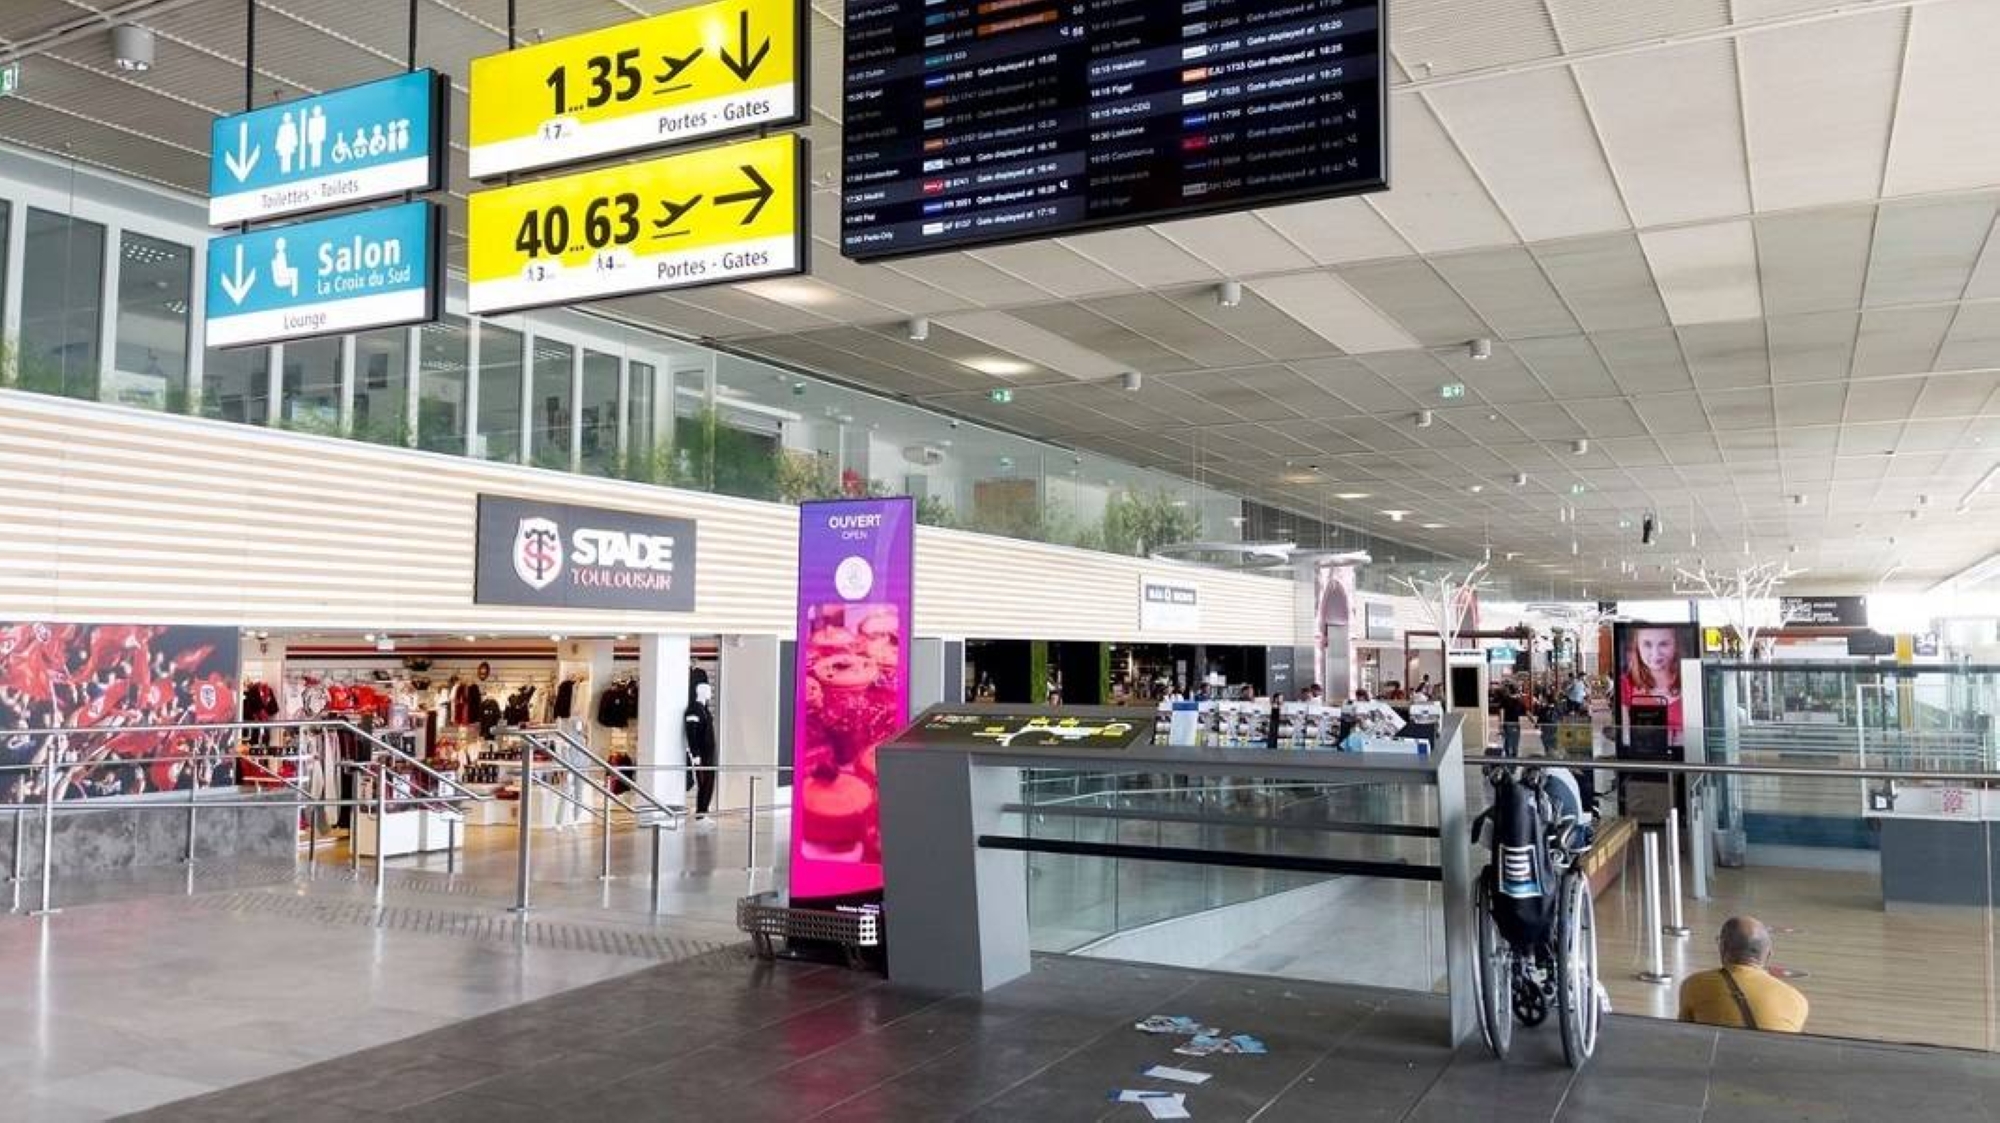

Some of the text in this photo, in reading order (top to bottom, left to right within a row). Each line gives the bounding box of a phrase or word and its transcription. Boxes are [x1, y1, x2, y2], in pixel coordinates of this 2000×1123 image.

[1247, 35, 1267, 47] Gate
[1268, 26, 1306, 44] displayed
[1307, 25, 1316, 35] at
[978, 67, 994, 78] Gate
[995, 59, 1026, 73] displayed
[1028, 58, 1035, 68] at
[1247, 58, 1267, 70] Gate
[1268, 49, 1306, 67] displayed
[1307, 48, 1316, 58] at
[1247, 81, 1267, 93] Gate
[1268, 73, 1306, 90] displayed
[1307, 72, 1316, 82] at
[659, 112, 708, 134] Portes
[723, 99, 771, 123] Gates
[1208, 111, 1220, 123] FR
[1247, 104, 1267, 116] Gate
[1268, 96, 1306, 113] displayed
[1307, 95, 1316, 106] at
[1247, 127, 1267, 139] Gate
[1268, 120, 1306, 136] displayed
[1307, 120, 1316, 130] at
[977, 152, 994, 162] Gate
[995, 146, 1025, 160] displayed
[1027, 145, 1035, 154] at
[977, 174, 993, 184] Gate
[995, 168, 1025, 182] displayed
[1027, 167, 1035, 176] at
[261, 190, 310, 209] Toilettes
[321, 179, 359, 197] Toilets
[976, 195, 993, 205] Gate
[995, 189, 1025, 204] displayed
[1027, 188, 1035, 197] at
[976, 217, 993, 226] Gate
[995, 211, 1025, 225] displayed
[1027, 210, 1035, 219] at
[318, 236, 401, 276] Salon
[658, 258, 706, 280] Portes
[723, 250, 769, 276] Gates
[318, 264, 411, 295] La Croix du Sud
[284, 312, 328, 331] Lounge
[829, 513, 882, 528] OUVERT
[841, 530, 867, 540] OPEN
[571, 528, 675, 571] STADE
[571, 568, 672, 591] TOULOUSAIN
